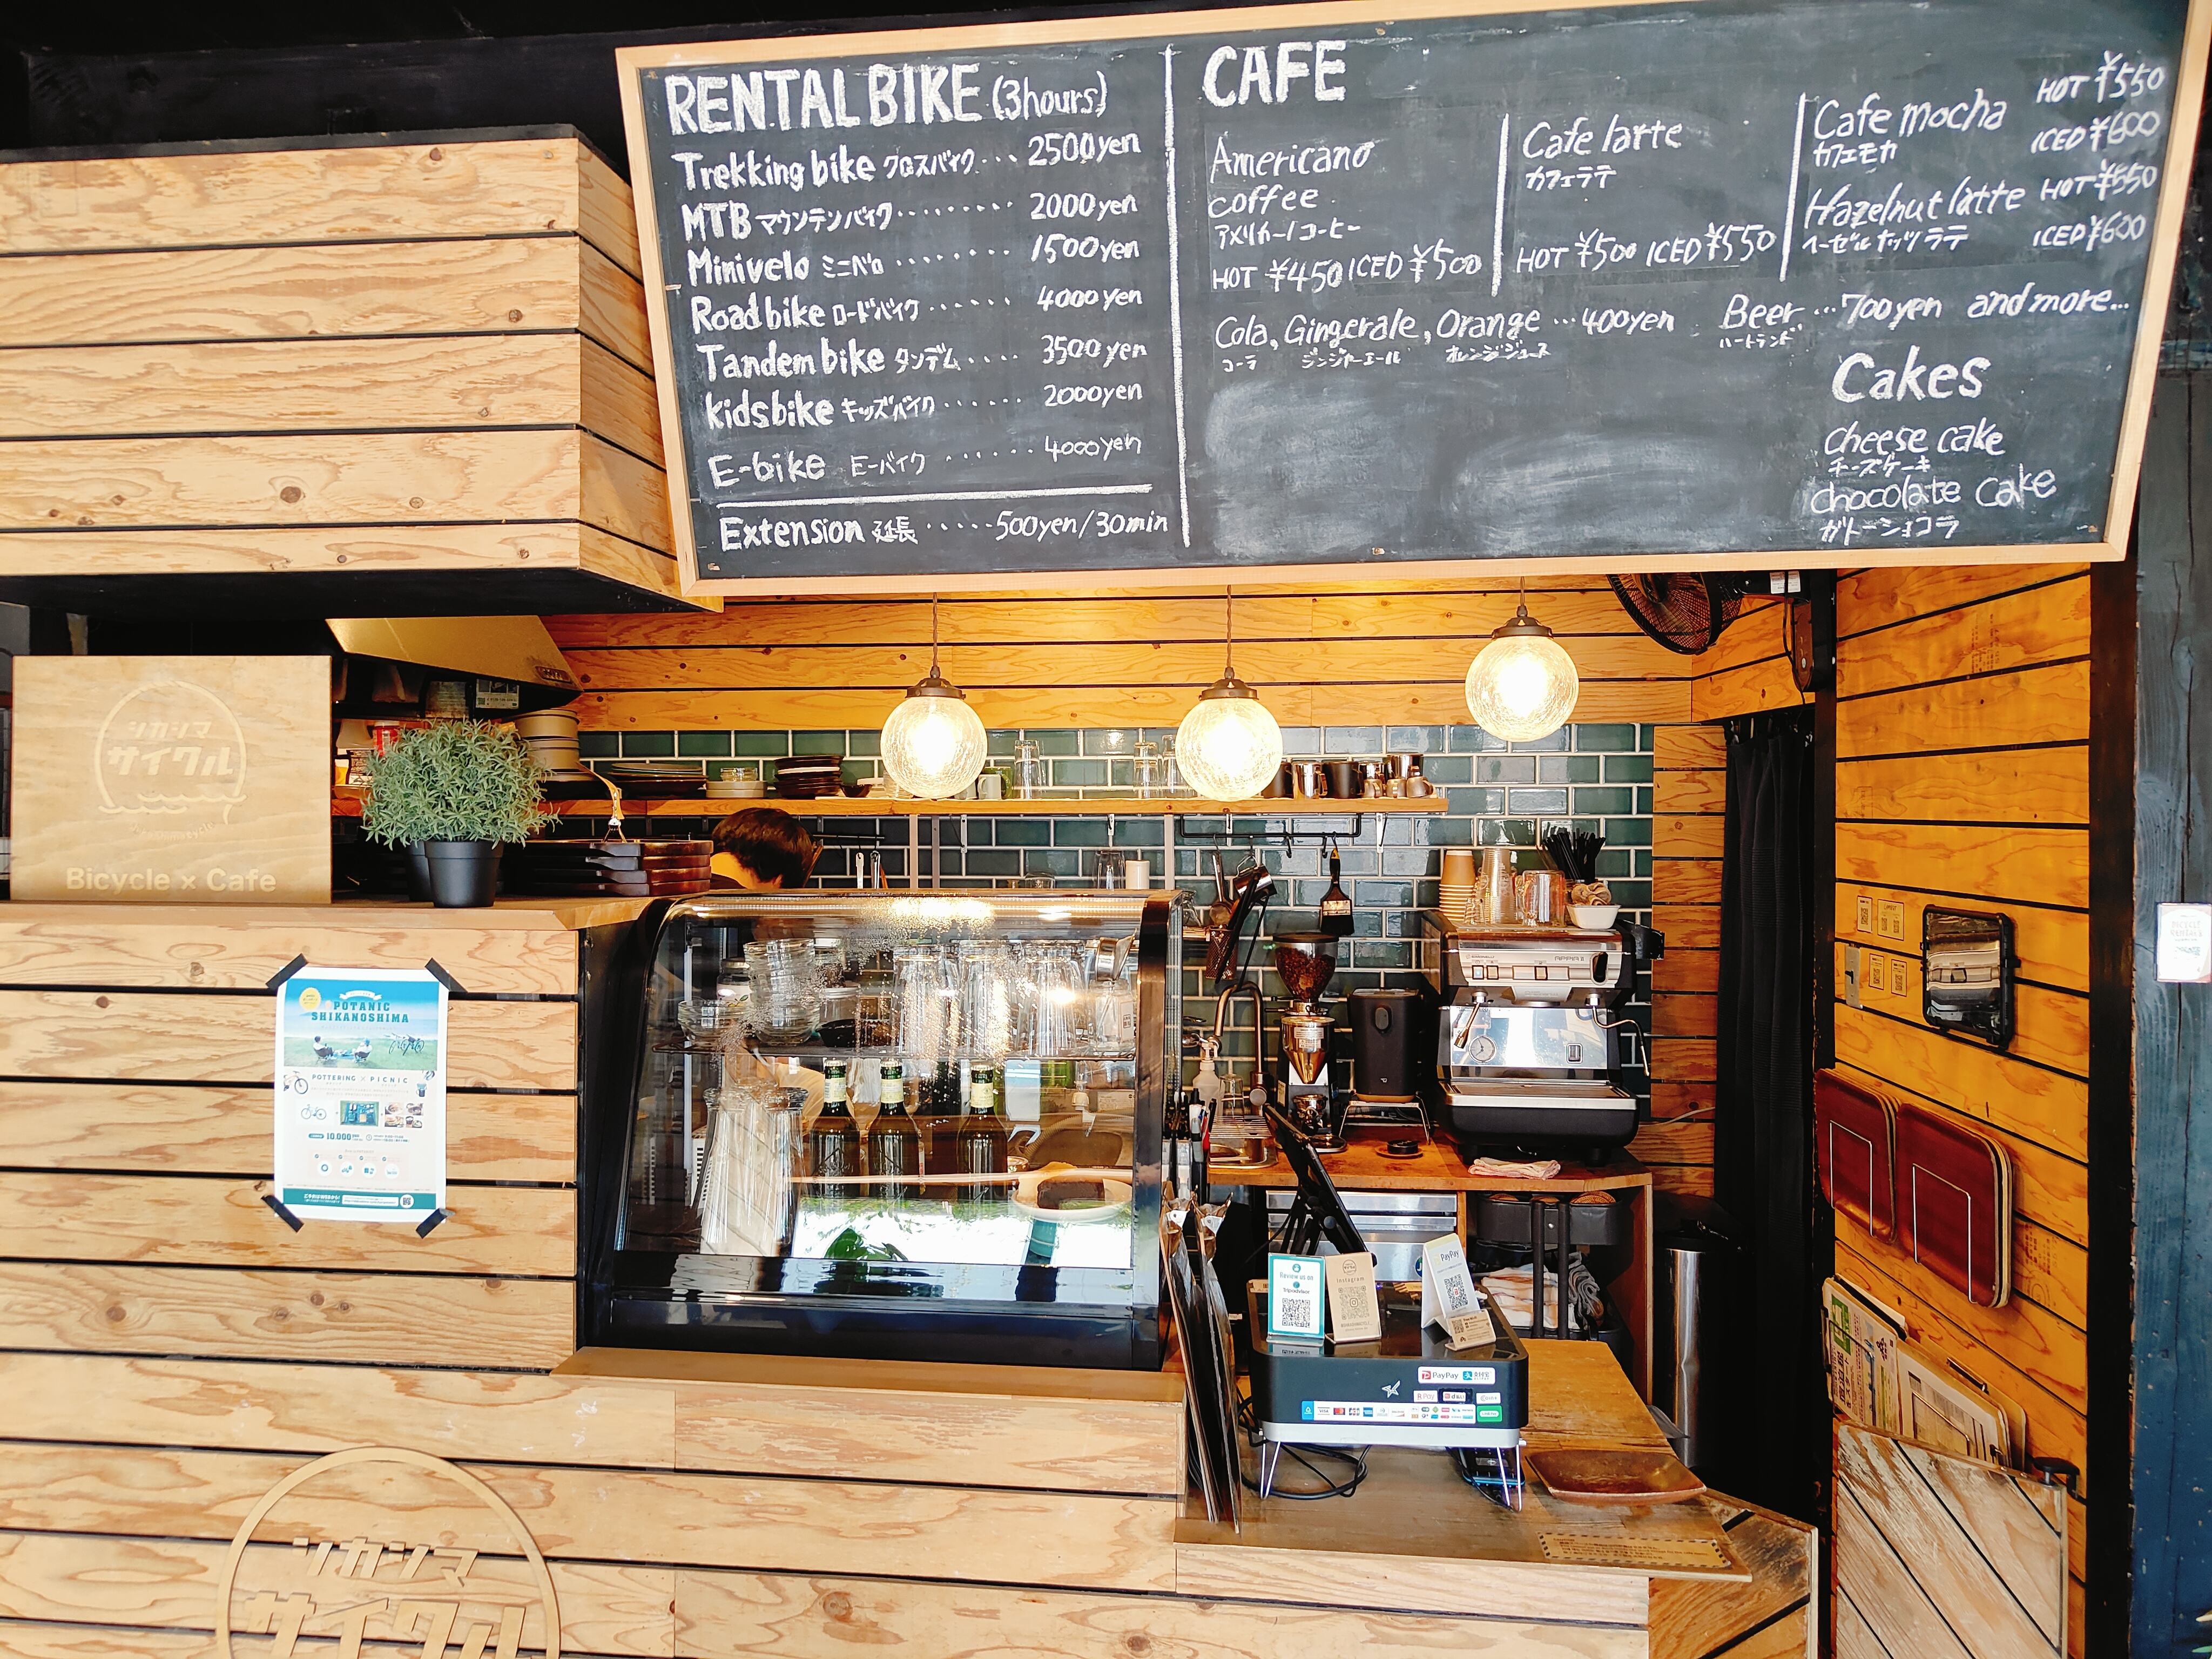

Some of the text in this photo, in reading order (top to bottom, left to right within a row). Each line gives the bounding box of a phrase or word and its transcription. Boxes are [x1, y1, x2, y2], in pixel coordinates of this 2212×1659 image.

[1203, 41, 1346, 106] CAFE
[2037, 76, 2089, 102] HOT
[665, 63, 1107, 134] RENTAL BIKE (3hours)
[1815, 89, 2006, 139] Cafe mocha
[1523, 114, 1682, 158] Cafe latte
[2032, 127, 2085, 153] ICED
[672, 151, 804, 191] Trekking
[812, 145, 875, 187] bike
[884, 149, 974, 178] クロスバイク
[1211, 137, 1374, 183] Americano
[1813, 140, 1897, 167] カフェモカ
[1526, 166, 1616, 190] カフェラテ
[2041, 176, 2096, 200] HOT
[1804, 177, 2025, 229] Hazelnut latte
[682, 201, 751, 240] MTB
[756, 203, 892, 234] マウンテンバイク
[2033, 224, 2085, 246] ICED
[688, 247, 808, 286] Minivelo
[823, 253, 883, 277] ミニベロ
[1213, 267, 1257, 289] HOT
[1349, 252, 1402, 280] ICED
[1517, 248, 1569, 272] HOT
[1647, 237, 1701, 266] ICED
[833, 299, 919, 325] ロードバイク
[1719, 294, 1805, 329] Beer
[1968, 283, 2034, 317] and
[1438, 310, 1539, 340] Orange
[696, 340, 816, 381] Tandem
[821, 338, 885, 376] bike
[895, 343, 960, 373] タンデム
[1223, 355, 1256, 371] コーラ
[1832, 346, 1990, 402] Cakes
[842, 396, 934, 422] キッズバイク
[1825, 418, 2005, 455] cheese cake
[709, 451, 825, 489] E-bike
[1829, 453, 1930, 477] チーズケーキ
[1808, 475, 1960, 513] chocolate
[720, 517, 865, 551] Extension
[872, 517, 917, 544] 延長
[1820, 516, 1959, 545] ガトーショコラ
[107, 746, 234, 777] サイクル
[66, 868, 171, 895] Bicycle
[207, 868, 276, 892] Cafe
[311, 1011, 409, 1023] SHIKANOSHIMA
[334, 1001, 390, 1011] POTANIC
[1440, 1250, 1459, 1262] PayPay
[293, 1536, 479, 1587] シカシマ
